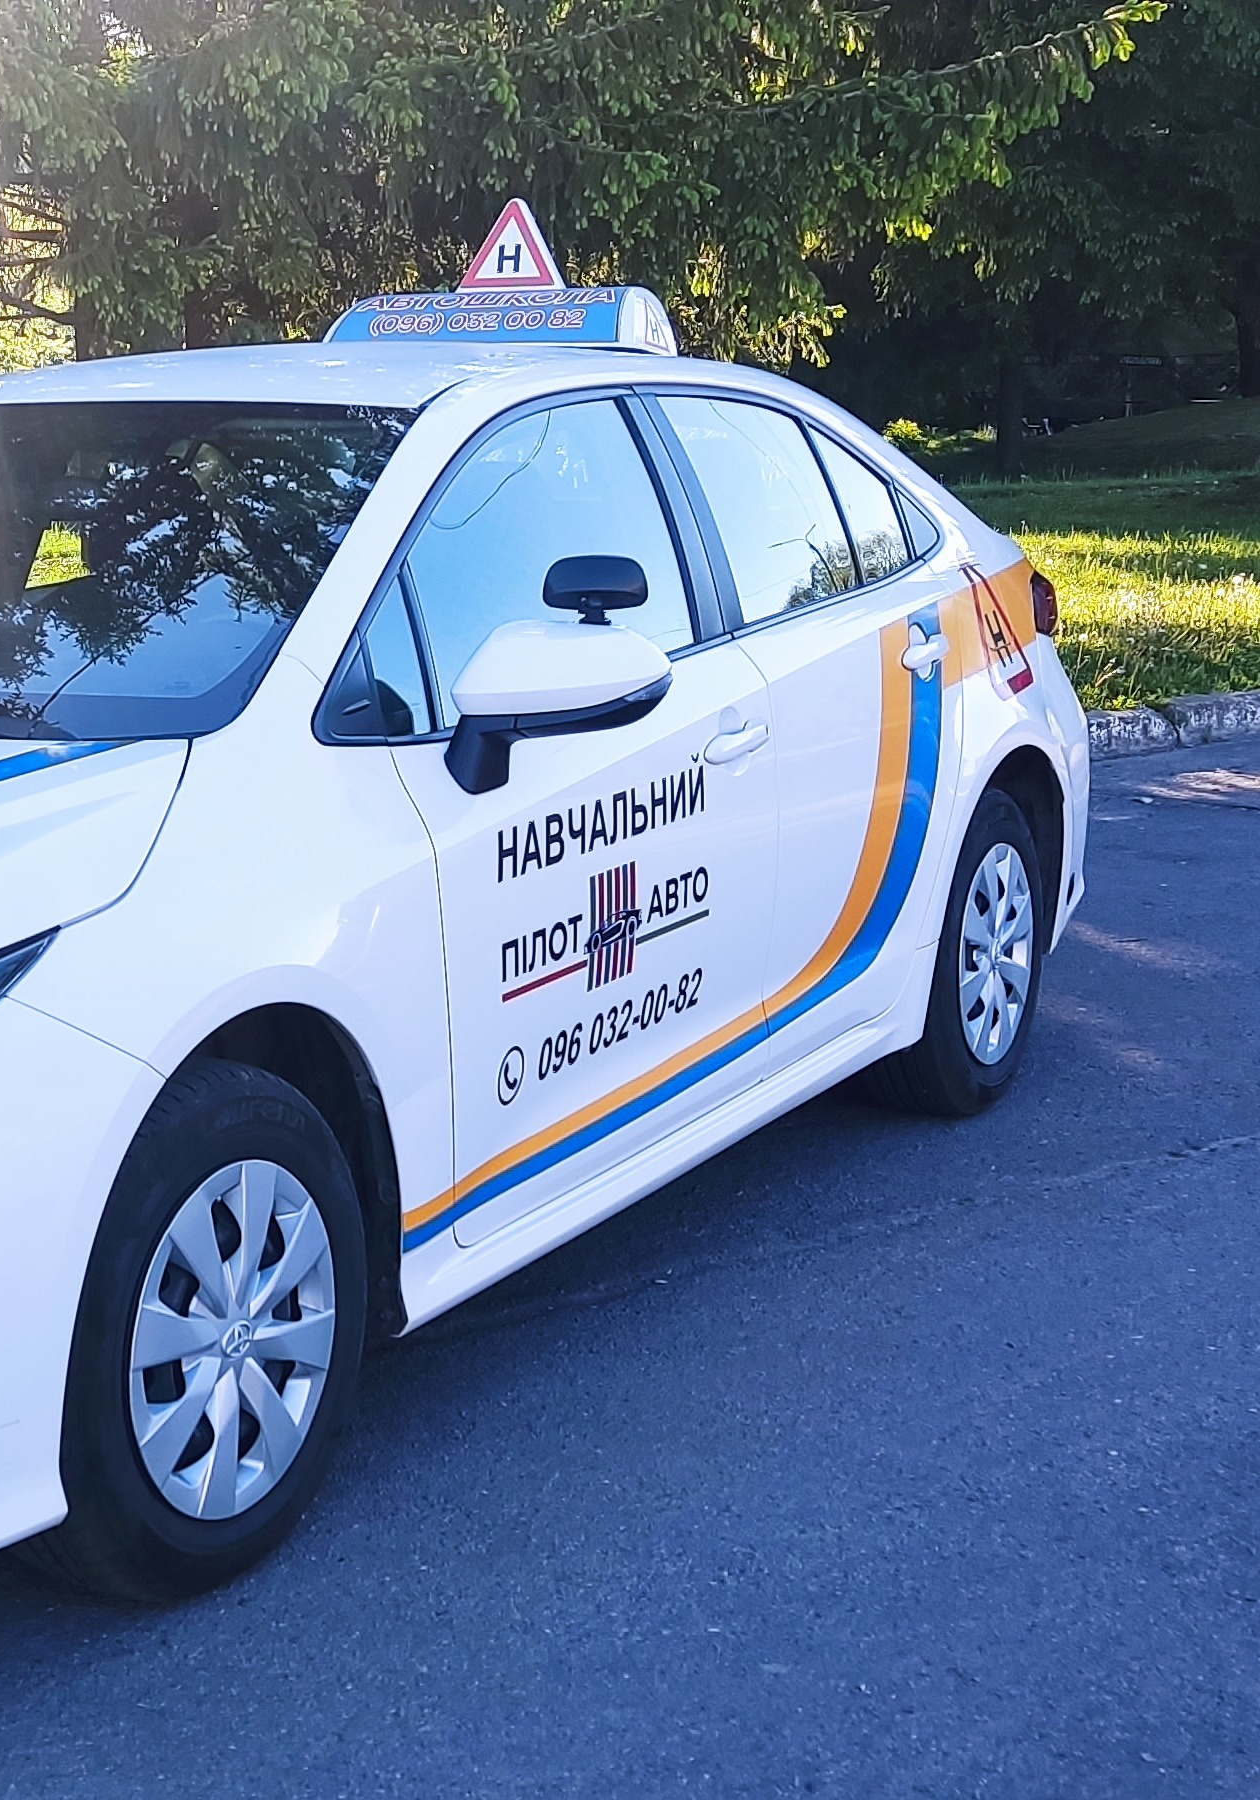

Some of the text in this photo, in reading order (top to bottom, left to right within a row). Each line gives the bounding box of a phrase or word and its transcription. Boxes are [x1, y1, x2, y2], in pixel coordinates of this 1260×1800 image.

[357, 289, 617, 312] АВТОШКОЛА
[369, 309, 586, 337] (096) 032 00 82
[497, 753, 706, 883] НАВЧАЛЬНИЙ
[502, 866, 710, 983] ПІЛОТ АВТО
[538, 968, 704, 1081] 096 032-00-82
